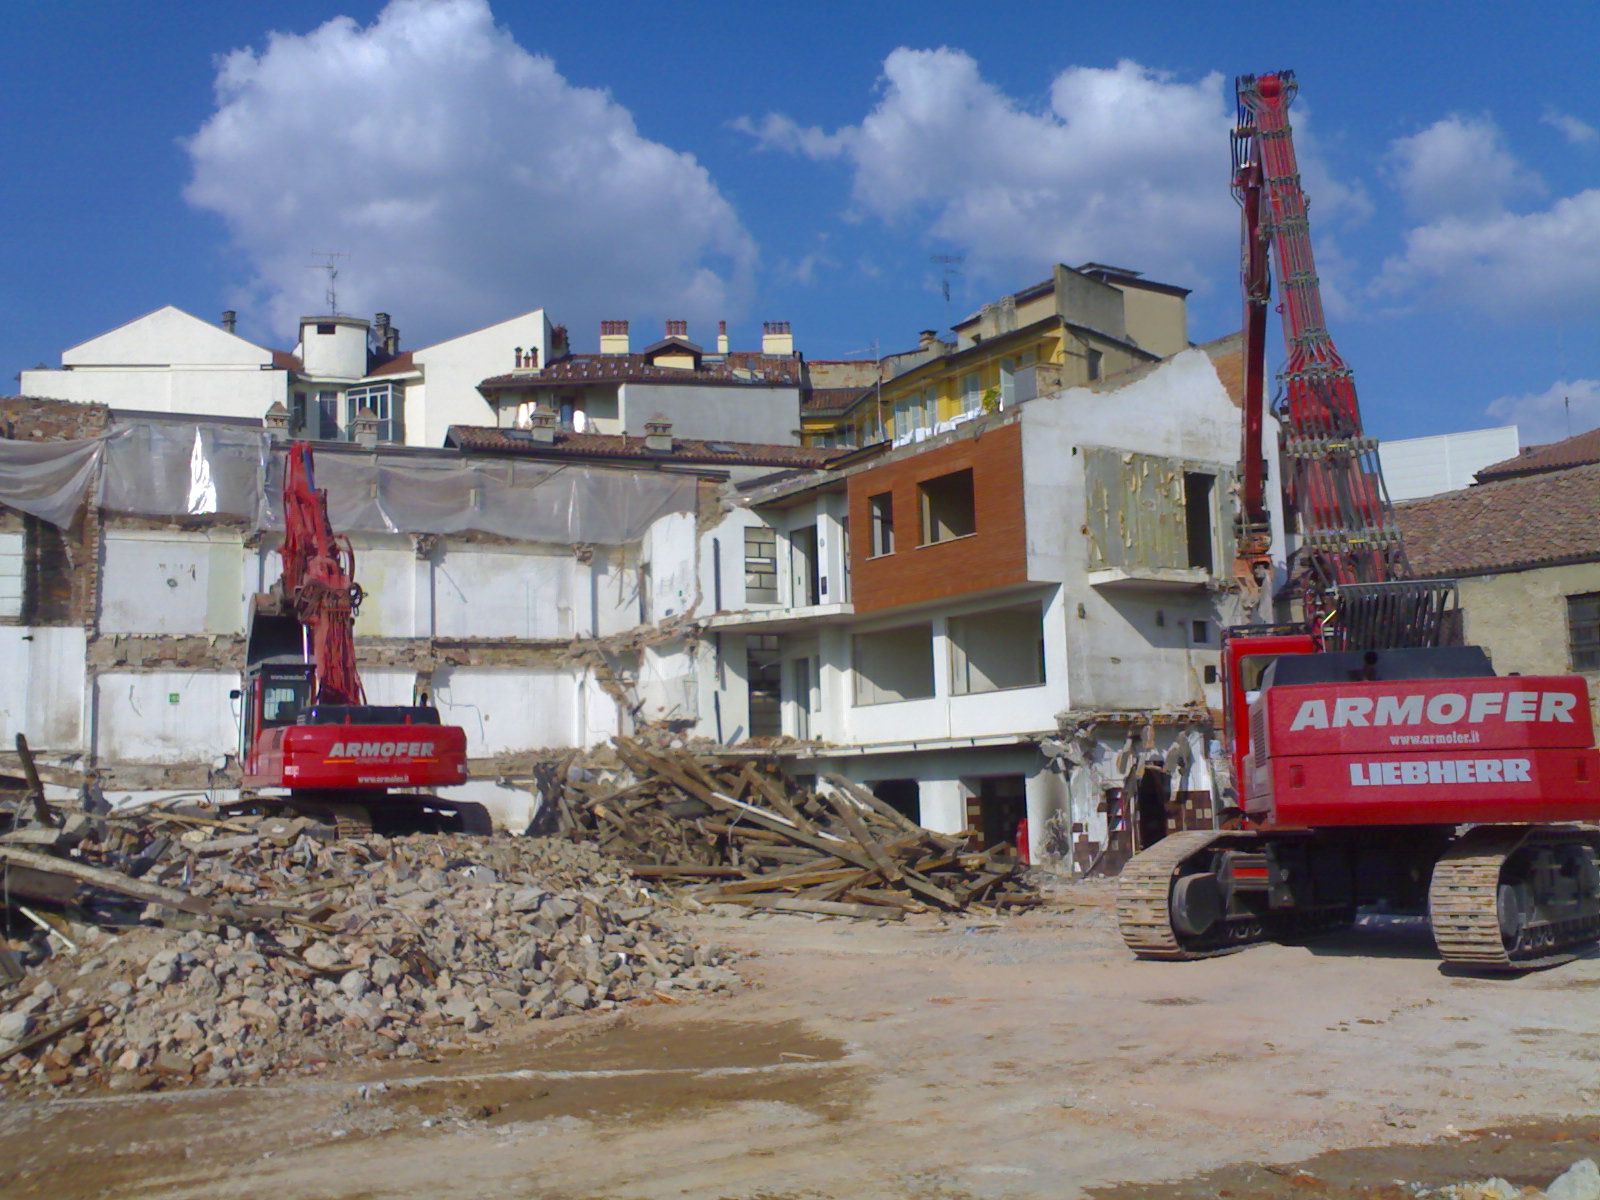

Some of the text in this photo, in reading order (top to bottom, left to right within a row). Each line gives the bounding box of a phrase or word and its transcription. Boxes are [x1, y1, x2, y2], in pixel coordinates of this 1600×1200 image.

[1289, 691, 1577, 731] ARMOFER
[1389, 730, 1480, 746] www.armofer.it
[328, 742, 435, 758] ARMOFER
[1350, 758, 1532, 786] LIEBHERR
